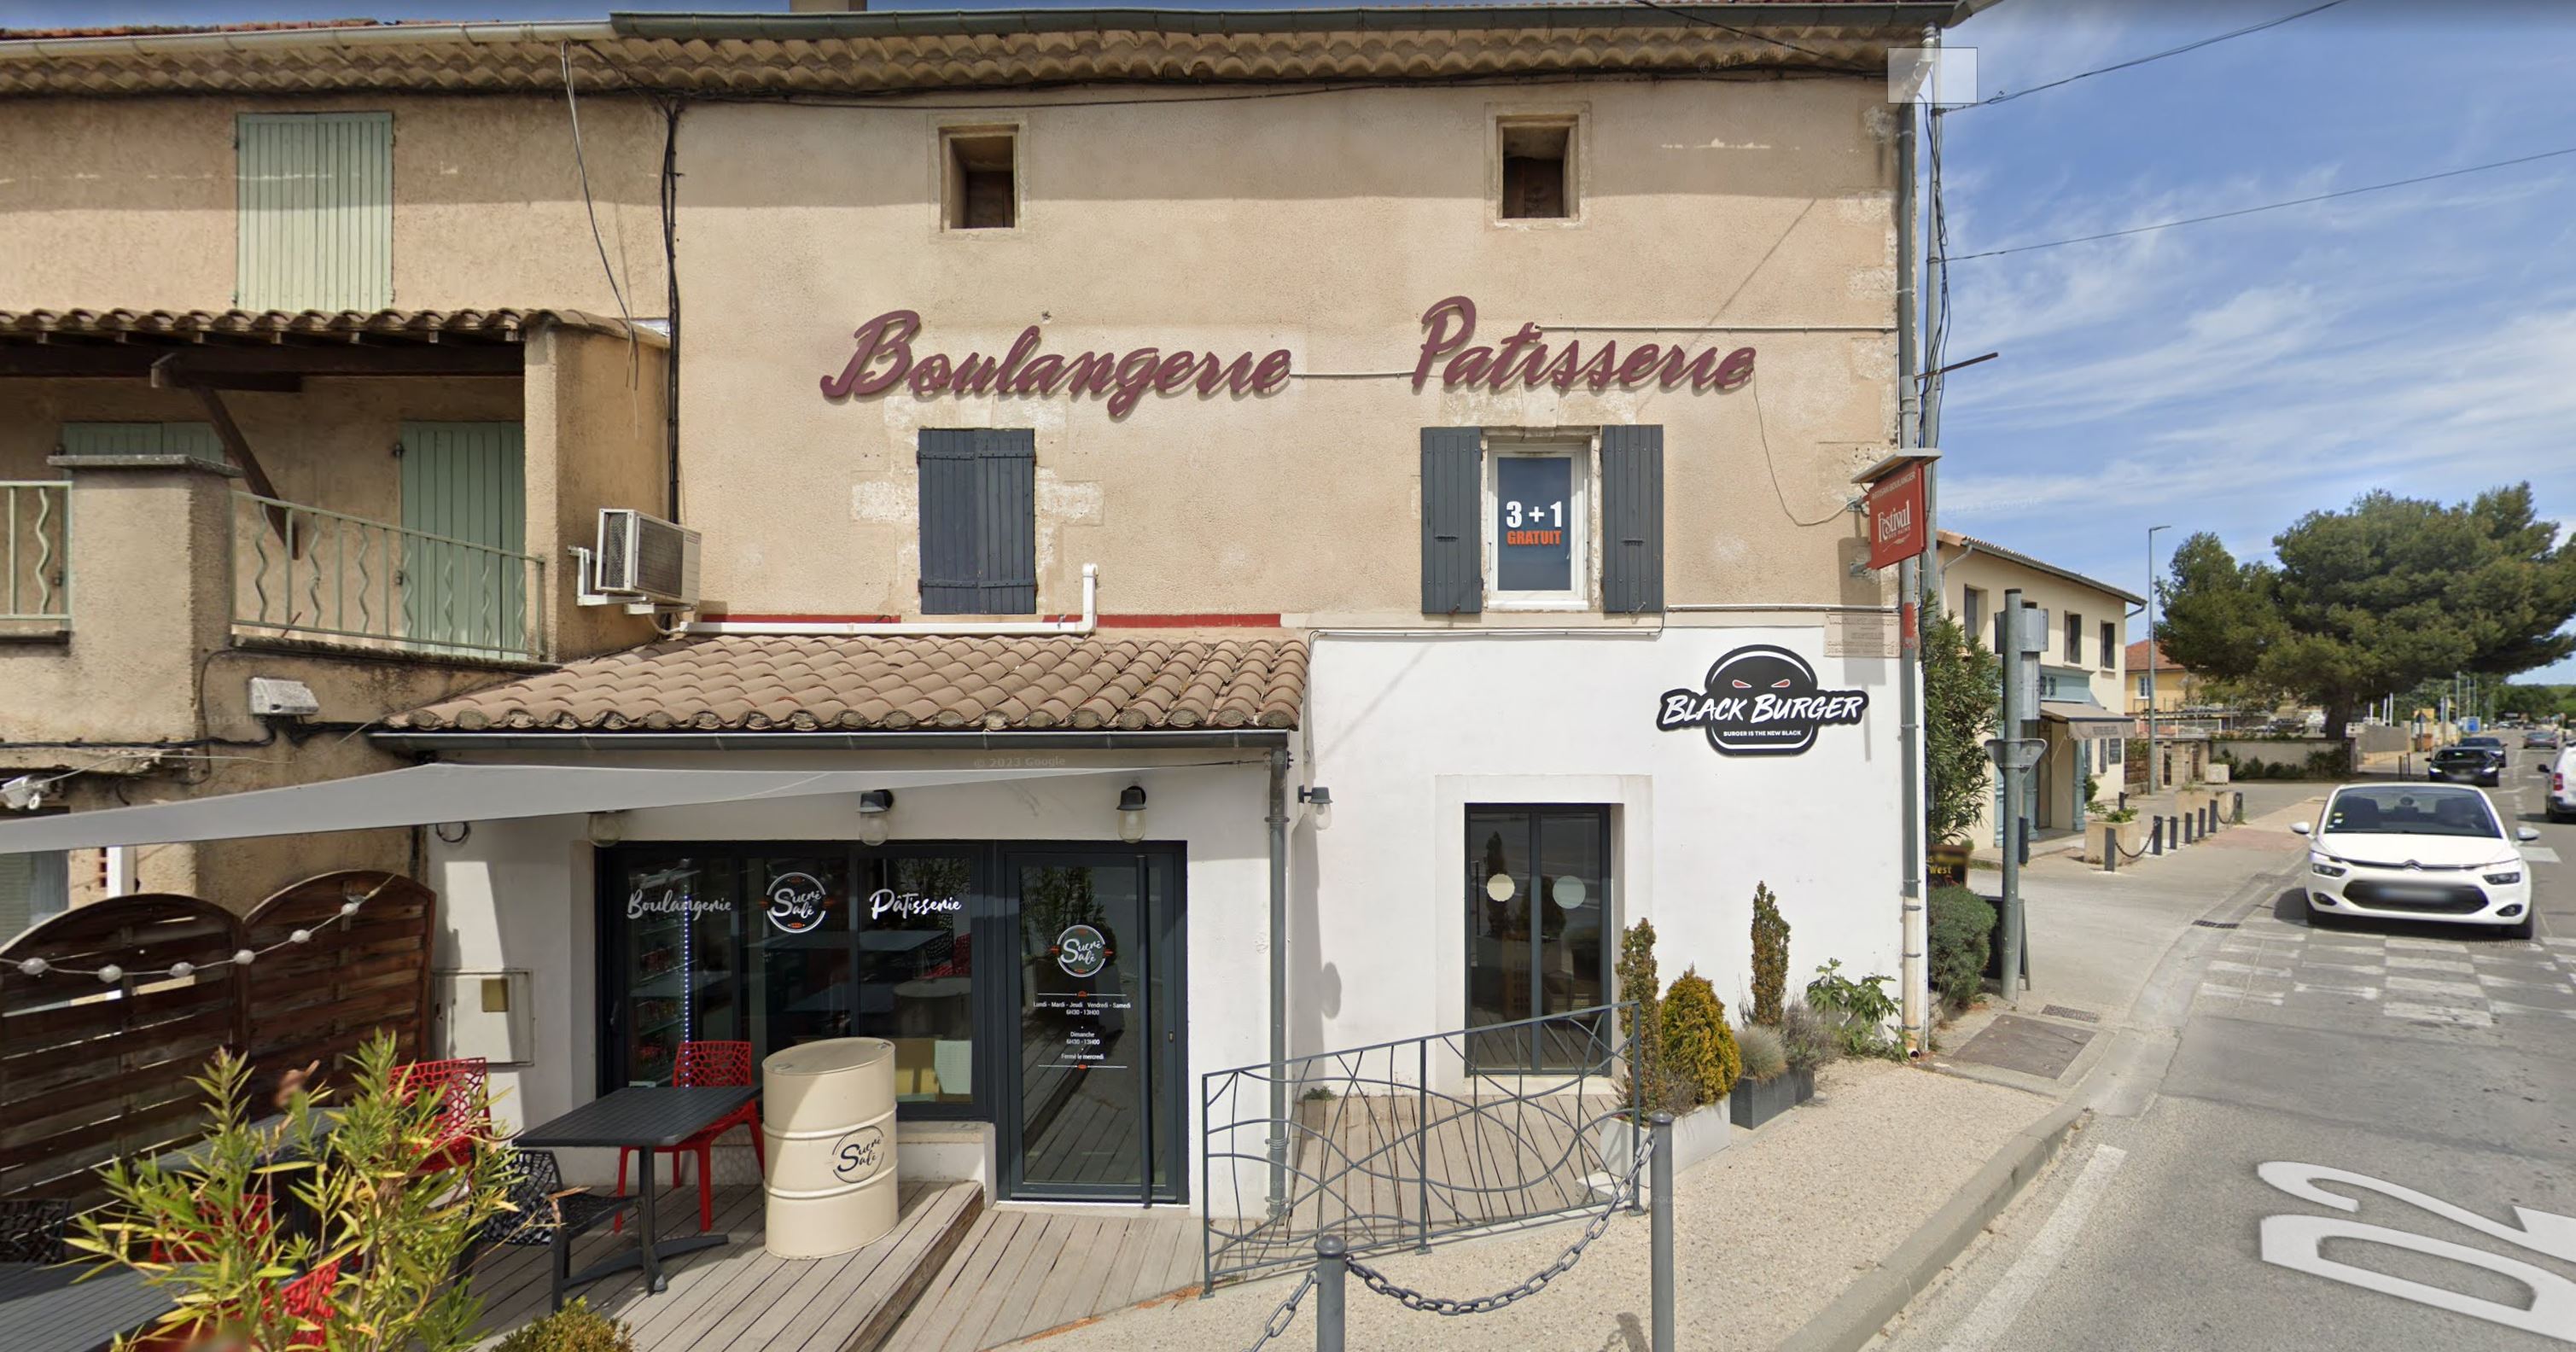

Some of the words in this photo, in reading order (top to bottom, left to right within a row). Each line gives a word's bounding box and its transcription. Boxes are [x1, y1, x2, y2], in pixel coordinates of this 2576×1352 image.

[1411, 295, 1757, 388] Patisserie
[819, 309, 1292, 418] Boulangerie
[1506, 501, 1522, 527] 3
[1550, 501, 1562, 527] 1
[1878, 499, 1911, 543] Festival
[1507, 530, 1562, 545] GRATUIT
[1663, 695, 1747, 725] BLACK
[1751, 693, 1863, 724] BURGER
[627, 889, 731, 920] Boulangerie
[869, 889, 961, 919] Pâtisserie
